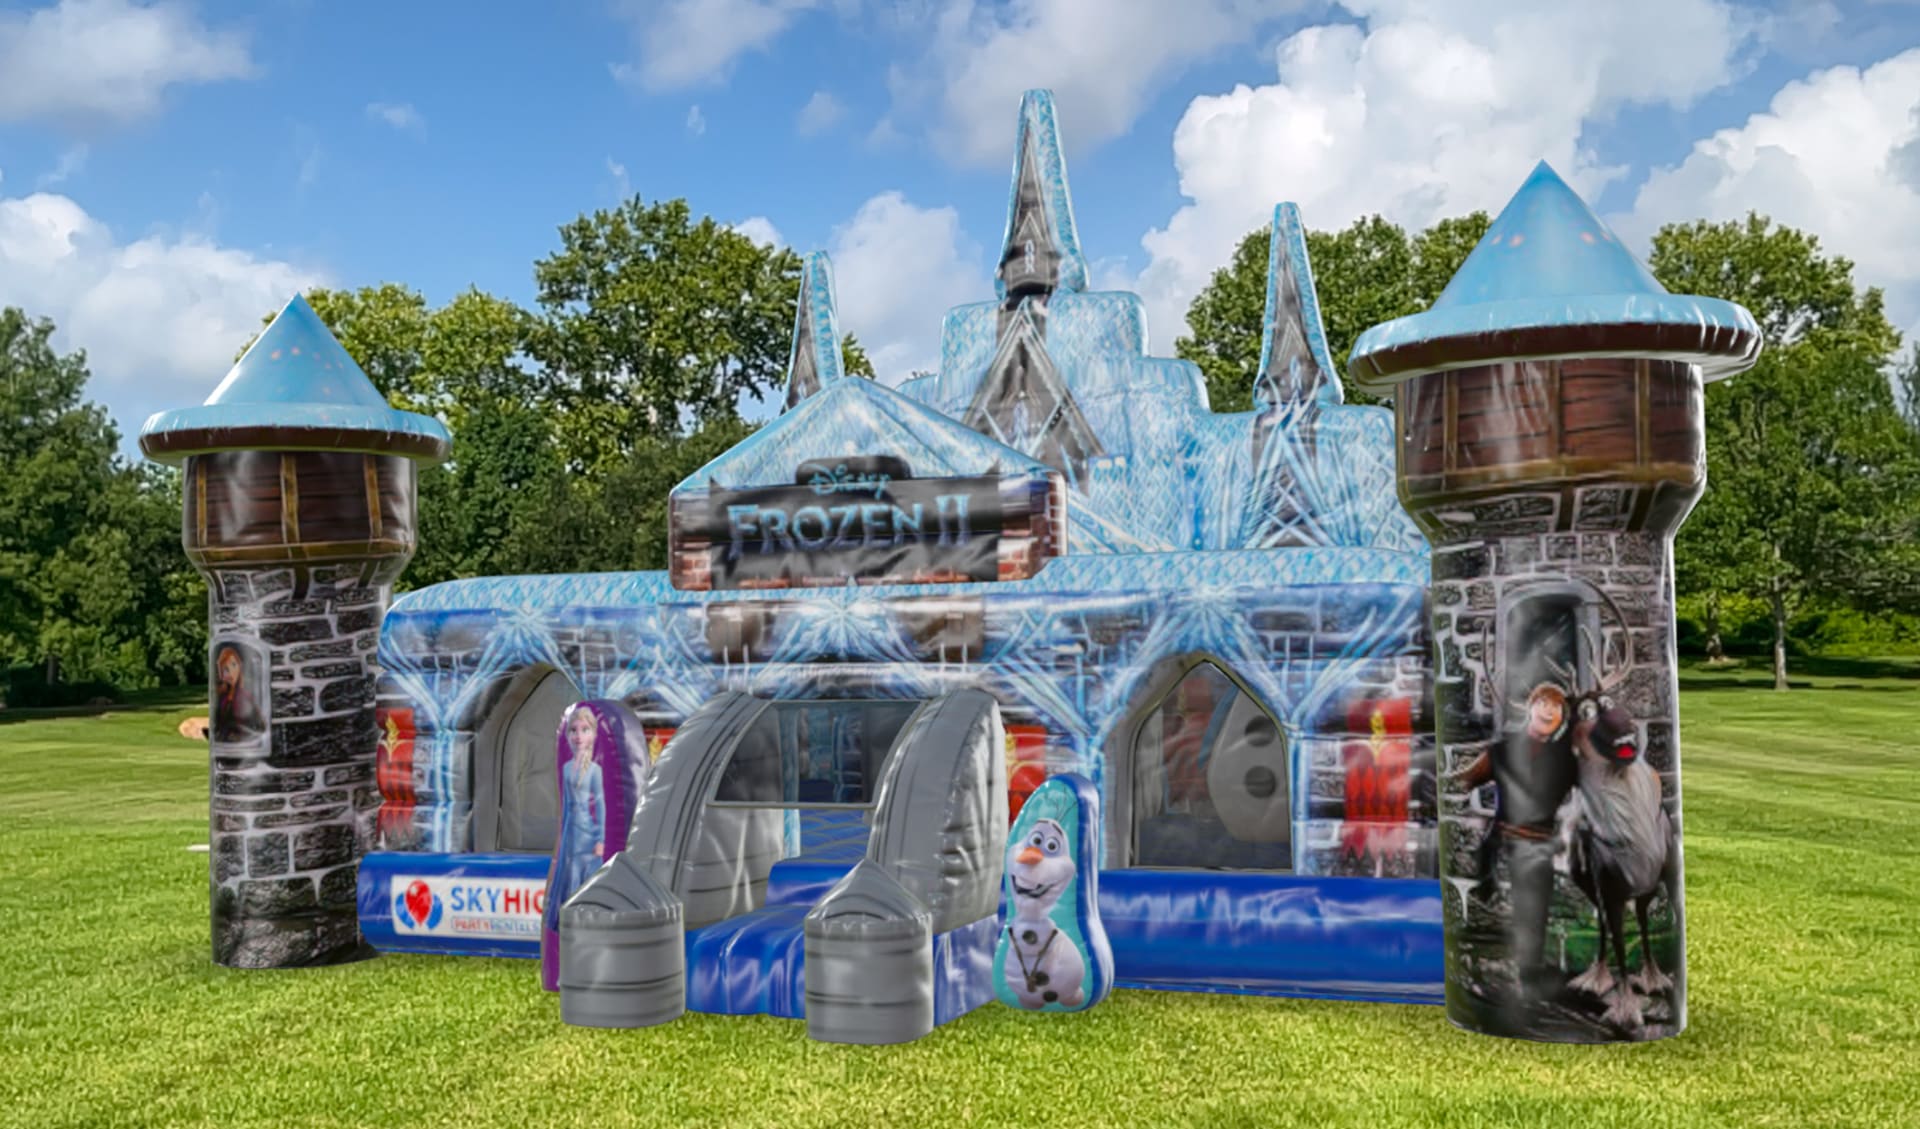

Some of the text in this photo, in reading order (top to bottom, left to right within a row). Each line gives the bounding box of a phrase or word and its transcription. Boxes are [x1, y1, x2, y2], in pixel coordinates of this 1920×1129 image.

[805, 463, 891, 499] Disney
[726, 494, 971, 561] FROZEN II
